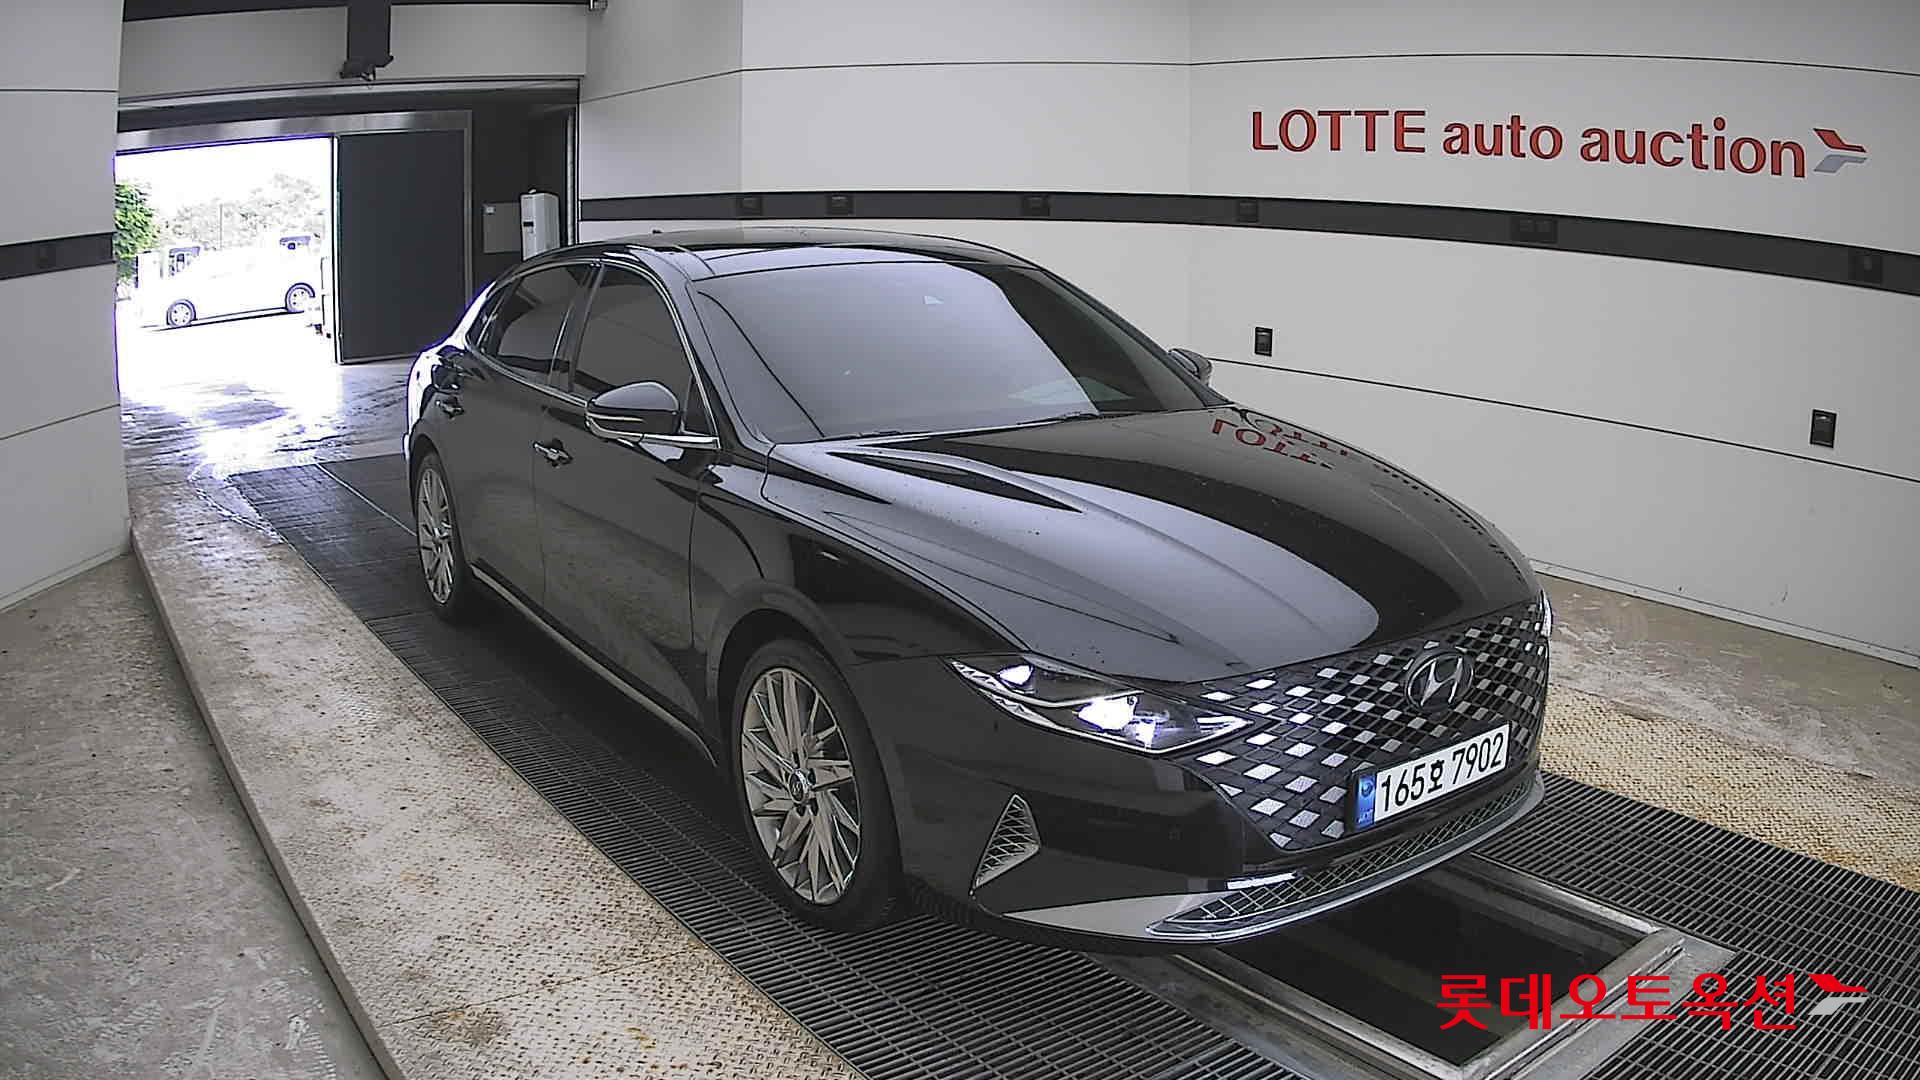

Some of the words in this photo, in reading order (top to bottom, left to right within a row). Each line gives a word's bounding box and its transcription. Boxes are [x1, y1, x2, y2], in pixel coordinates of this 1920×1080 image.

[1251, 109, 1426, 153] LOTTE
[1442, 115, 1564, 160] auto
[1580, 116, 1806, 178] auction
[1381, 759, 1445, 812] 165호
[1451, 732, 1504, 785] 7902
